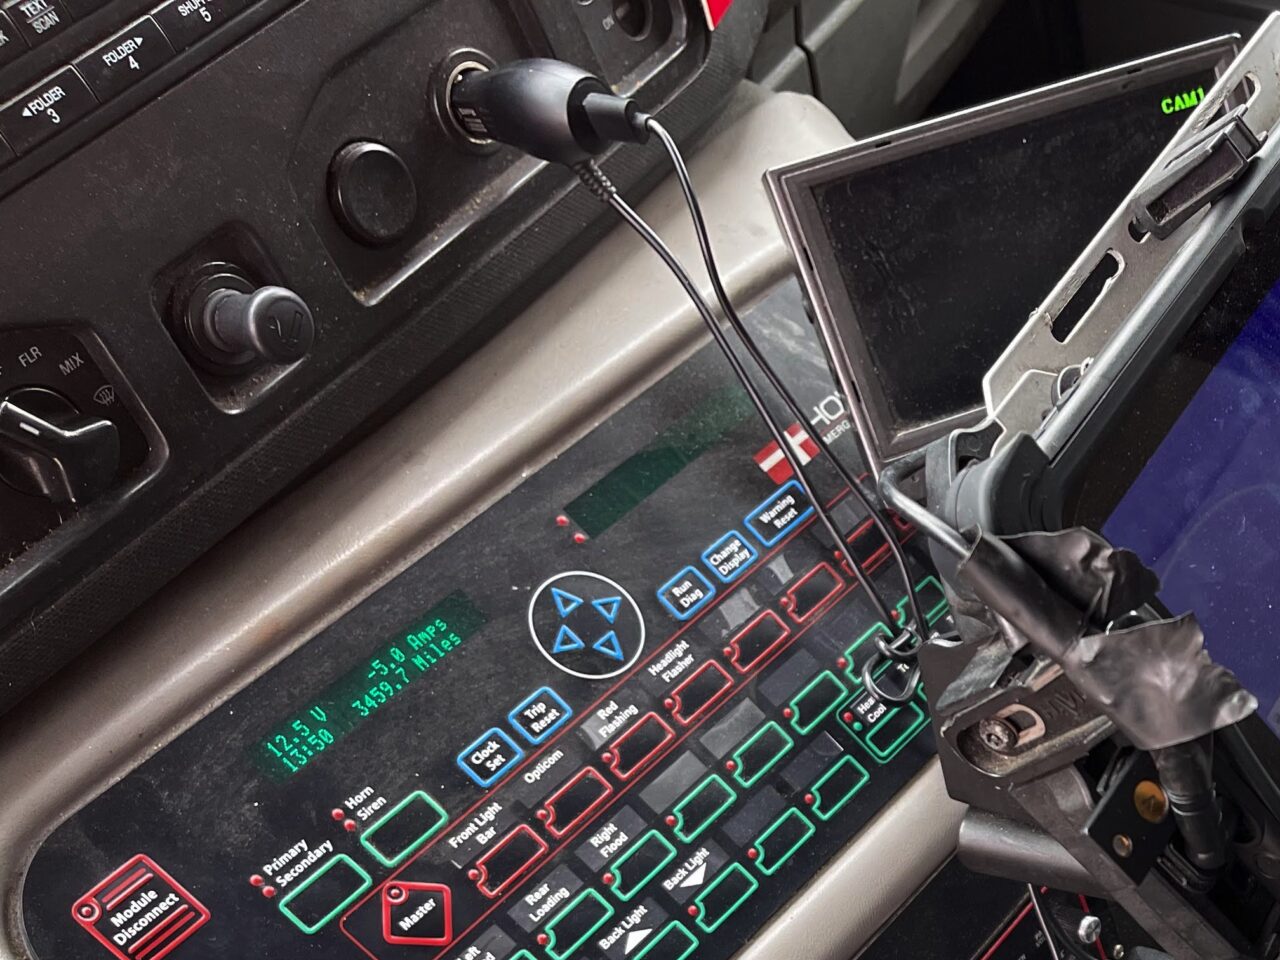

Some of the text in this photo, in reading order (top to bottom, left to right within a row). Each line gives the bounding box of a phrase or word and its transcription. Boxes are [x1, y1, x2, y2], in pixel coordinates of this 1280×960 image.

[32, 10, 60, 34] SCAN
[199, 7, 212, 22] 5
[102, 39, 137, 67] FOLDER
[128, 56, 140, 70] 4
[28, 86, 66, 115] FOLDER
[1161, 88, 1205, 115] CAM1
[47, 108, 61, 124] 3
[18, 346, 42, 367] FLR
[59, 352, 84, 376] MIX
[758, 494, 796, 524] Warning
[773, 507, 798, 529] Reset
[709, 539, 742, 566] Change
[718, 548, 751, 576] Display
[671, 580, 692, 598] Run
[679, 588, 704, 608] Diag
[367, 619, 447, 679] -5.0 Amps
[647, 639, 690, 677] Headlight
[351, 632, 462, 717] 3459.7 Miles
[661, 653, 695, 683] Flasher
[524, 702, 547, 721] Trip
[530, 708, 560, 733] Reset
[597, 701, 619, 721] Red
[599, 704, 639, 738] Flashing
[867, 703, 887, 723] Cool
[267, 706, 327, 757] 12.5 V
[283, 728, 334, 772] 13:50
[471, 740, 501, 765] Clock
[486, 754, 507, 772] Set
[524, 749, 564, 784] Opticom
[344, 785, 375, 810] Horn
[356, 795, 387, 821] Siren
[448, 802, 503, 849] Front Light
[476, 826, 497, 846] Bar
[590, 823, 618, 848] Right
[262, 839, 309, 876] Primary
[600, 832, 629, 859] Flood
[275, 840, 334, 887] Secondary
[662, 848, 711, 891] Back Light
[525, 882, 550, 906] Rear
[529, 887, 571, 923] Loading
[110, 890, 158, 927] Module
[113, 893, 180, 946] Disconnect
[399, 898, 436, 931] Master
[598, 905, 648, 951] Back Light
